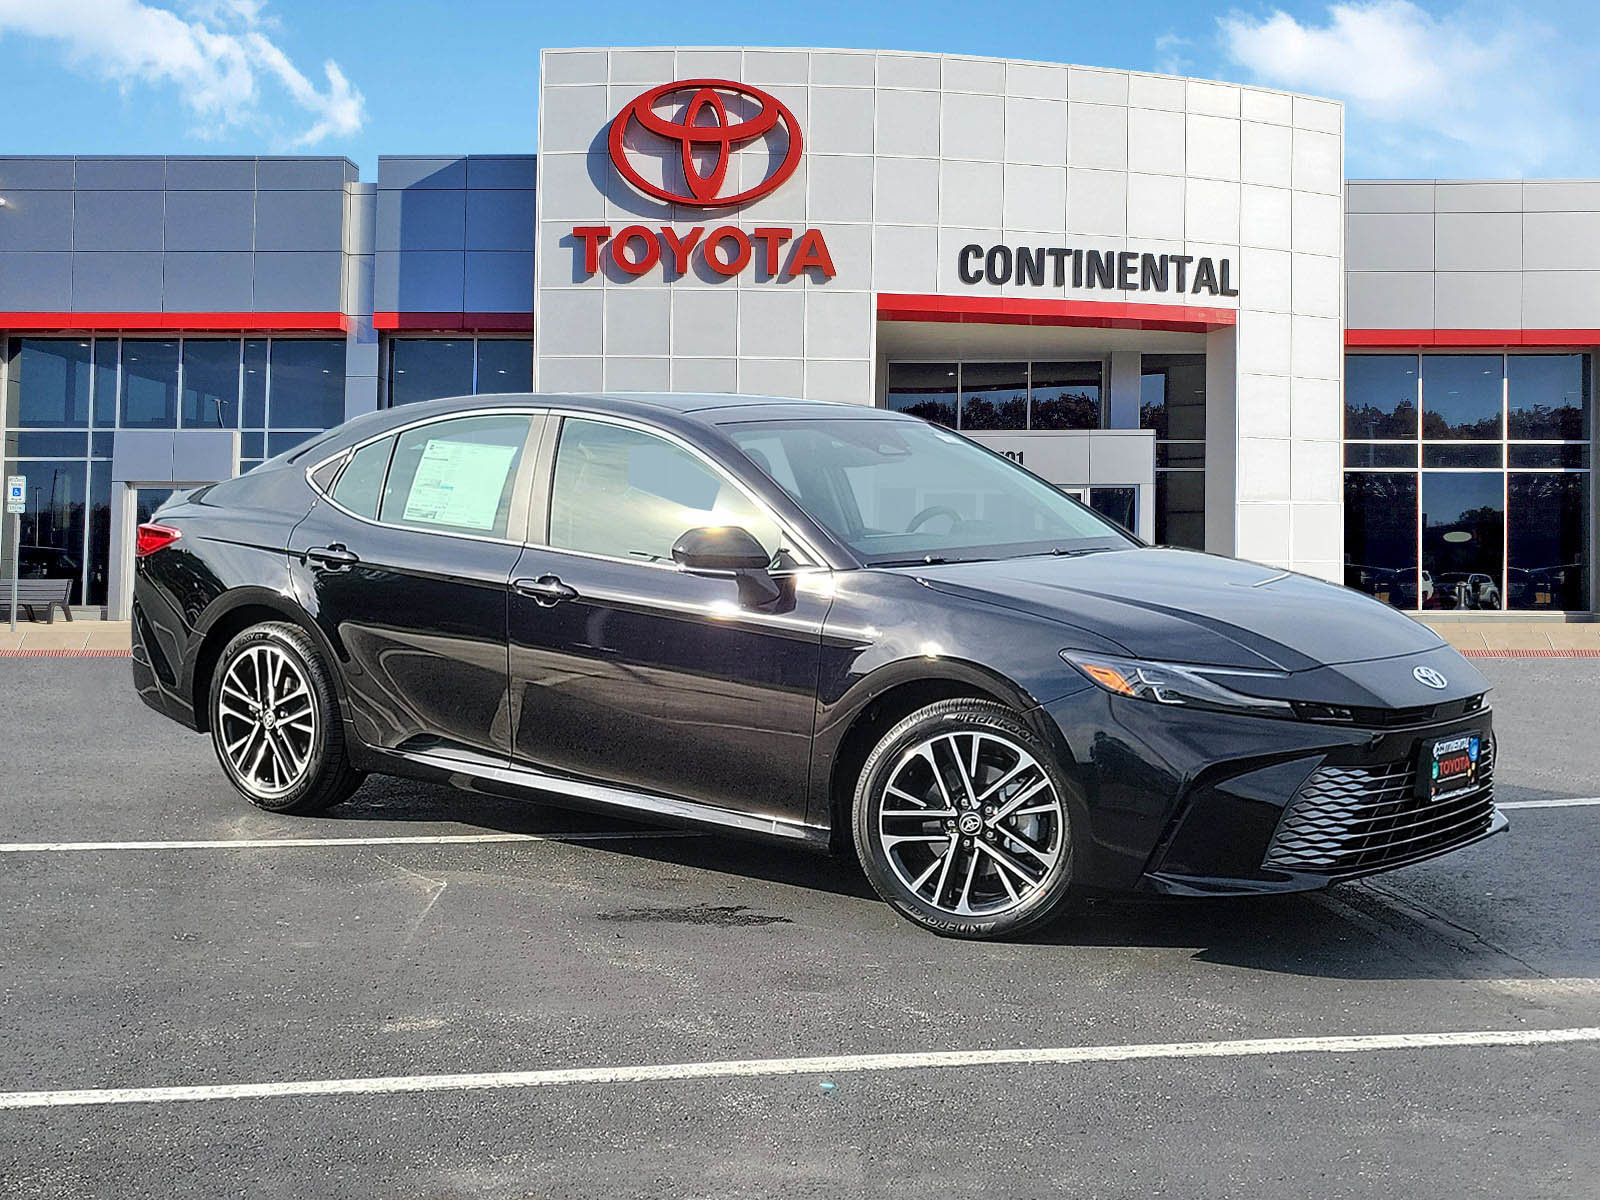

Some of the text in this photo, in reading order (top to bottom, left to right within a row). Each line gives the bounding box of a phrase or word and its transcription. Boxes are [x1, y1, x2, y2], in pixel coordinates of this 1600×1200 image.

[573, 225, 836, 276] TOYOTA
[958, 244, 1239, 297] CONTINENTAL
[999, 450, 1024, 466] 01
[1438, 755, 1471, 776] TOYOTA
